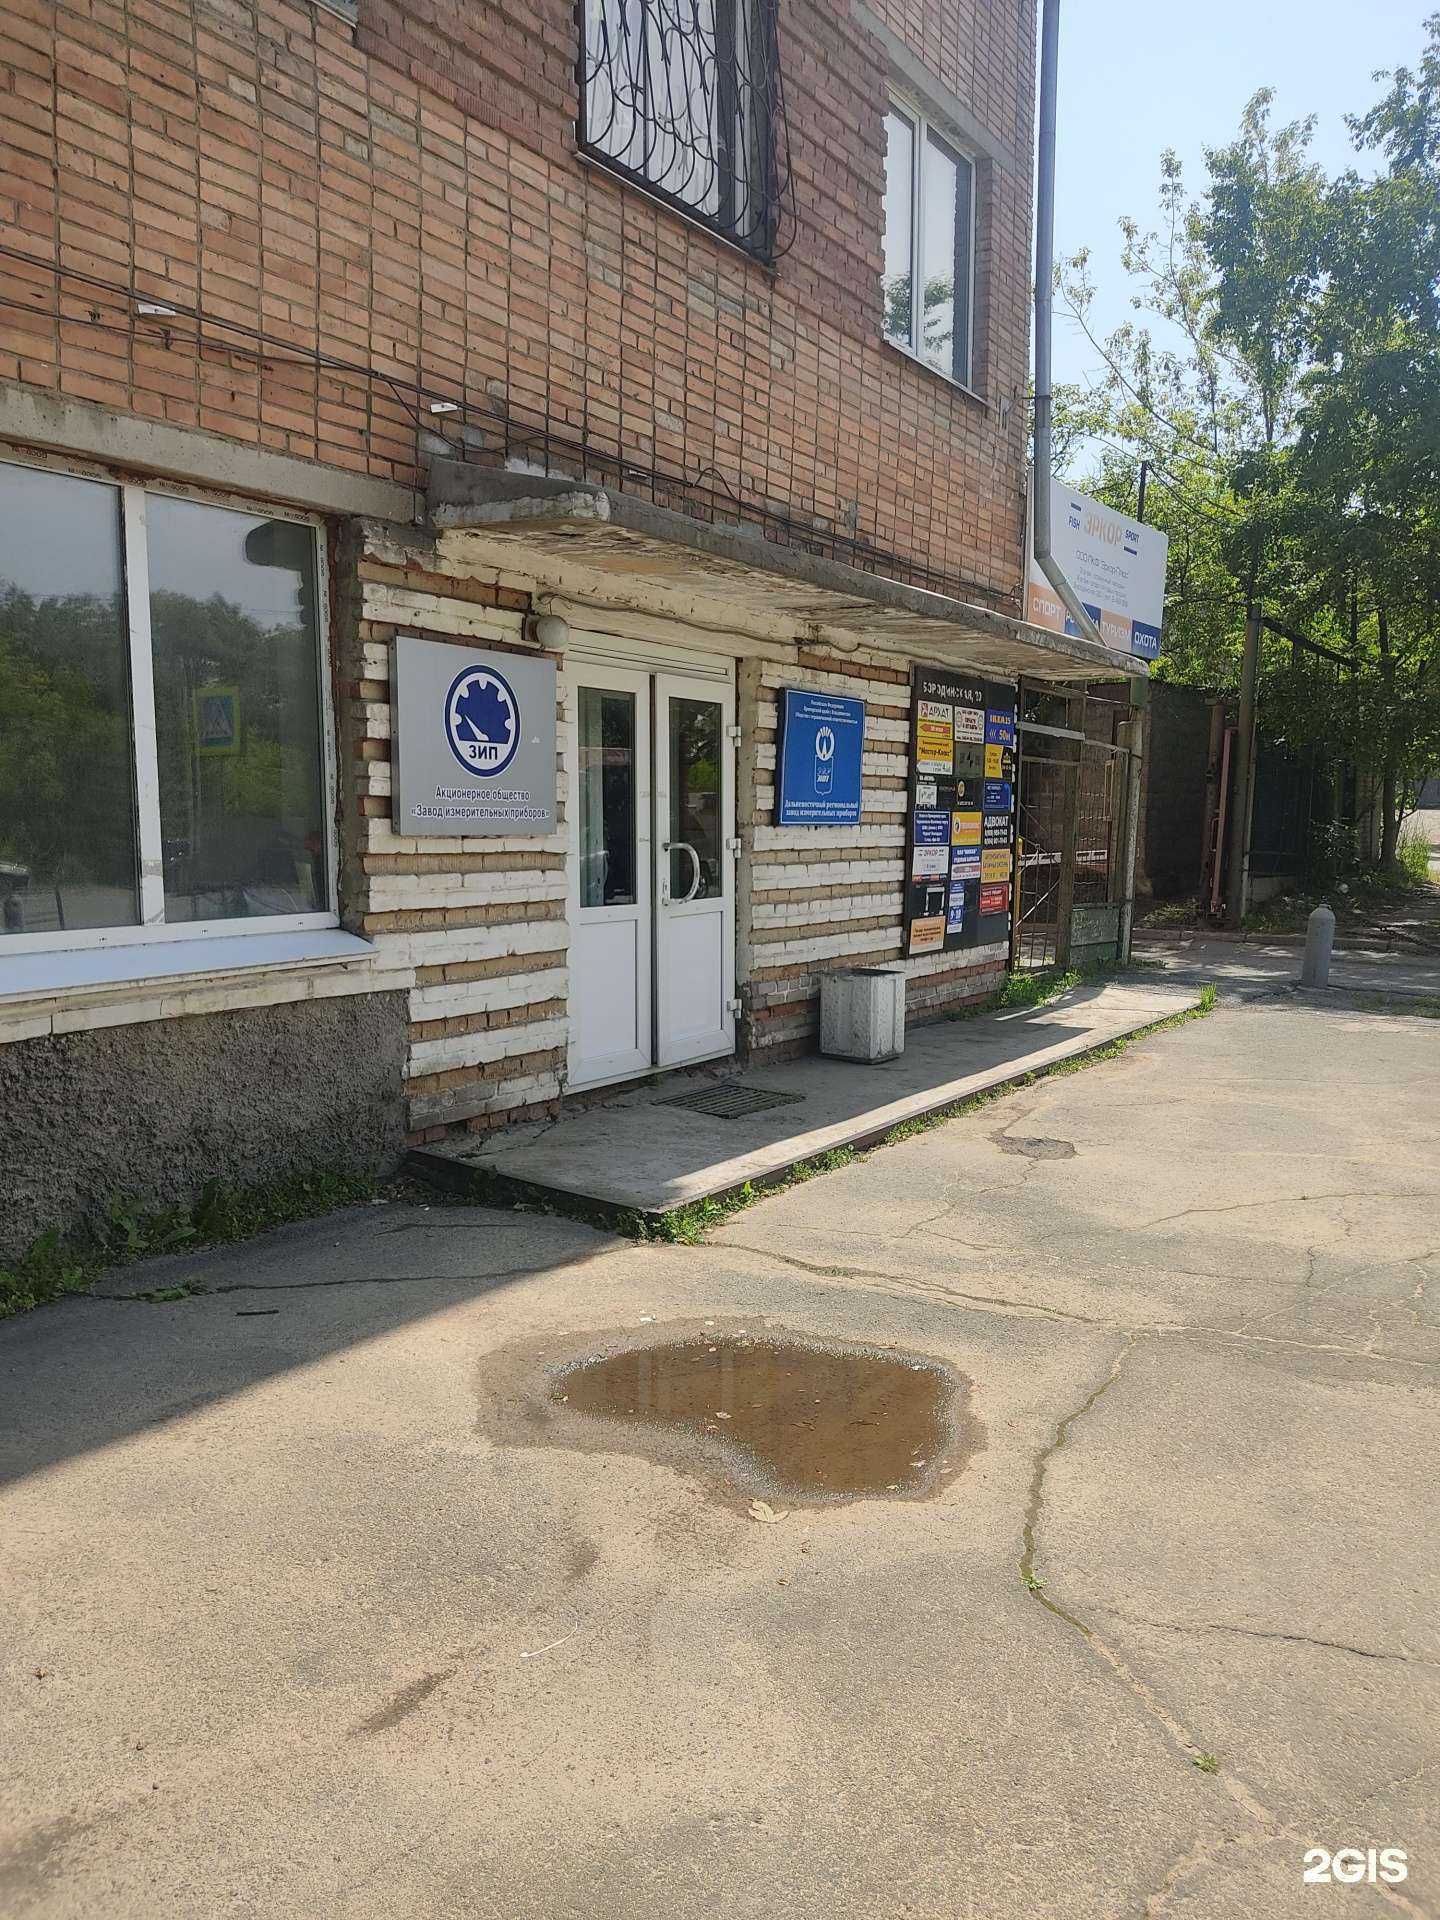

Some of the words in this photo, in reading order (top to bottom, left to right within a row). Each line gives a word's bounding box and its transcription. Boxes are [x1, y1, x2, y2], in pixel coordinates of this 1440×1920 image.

[1068, 515, 1081, 530] FISH
[1084, 512, 1121, 545] ЭРКОР
[1125, 529, 1140, 543] SPORT
[1032, 597, 1060, 617] СПОРТ
[1134, 631, 1158, 650] ОХОТА
[468, 744, 499, 761] ЗИП
[435, 785, 491, 801] Акционерное
[492, 788, 530, 802] общество
[444, 807, 509, 820] измерительных
[984, 815, 1009, 829] АДВОКАТ
